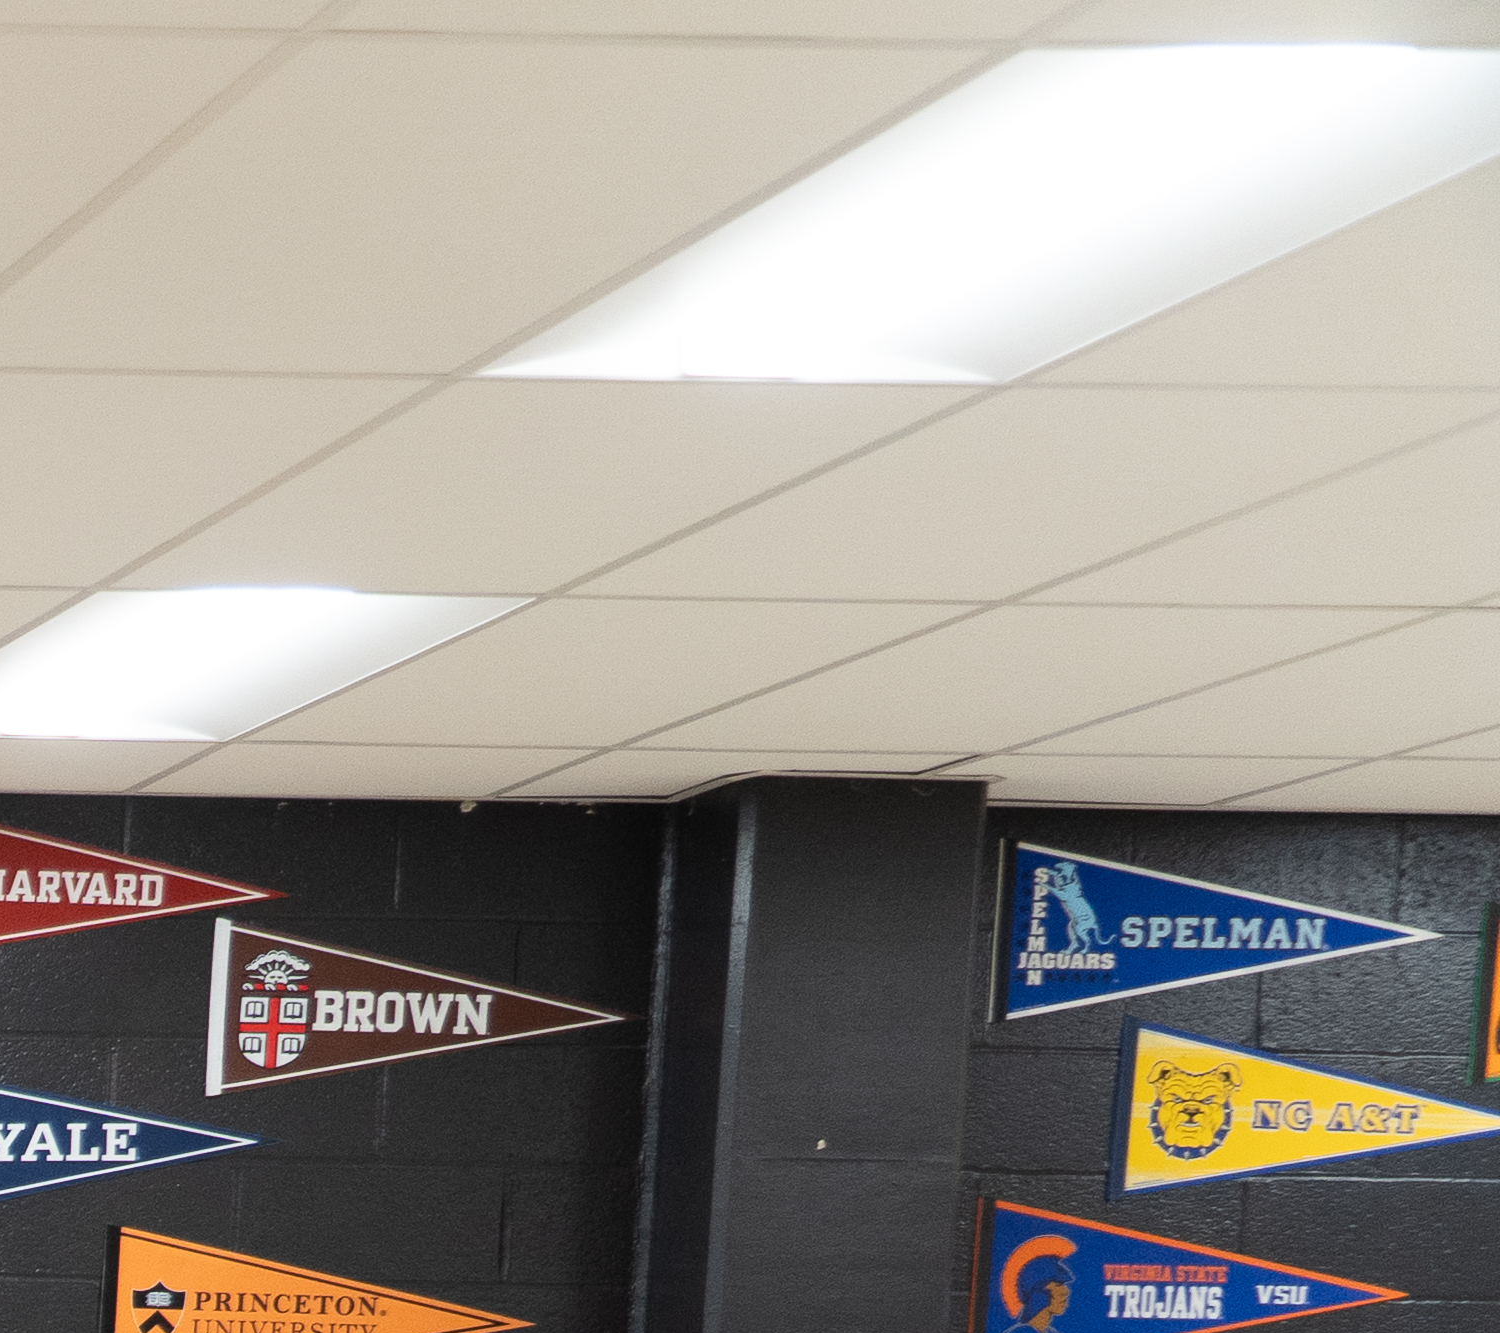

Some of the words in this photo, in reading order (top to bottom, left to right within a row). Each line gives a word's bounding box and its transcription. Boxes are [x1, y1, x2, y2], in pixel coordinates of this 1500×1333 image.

[1120, 916, 1327, 950] SPELMAN
[1017, 952, 1116, 970] JAGUARS
[312, 990, 492, 1035] BROWN
[1252, 1100, 1313, 1131] NC
[1326, 1102, 1420, 1134] A&T
[193, 1291, 379, 1316] PRINCETON
[1104, 1284, 1223, 1320] TROJANS
[1255, 1285, 1309, 1305] VSU
